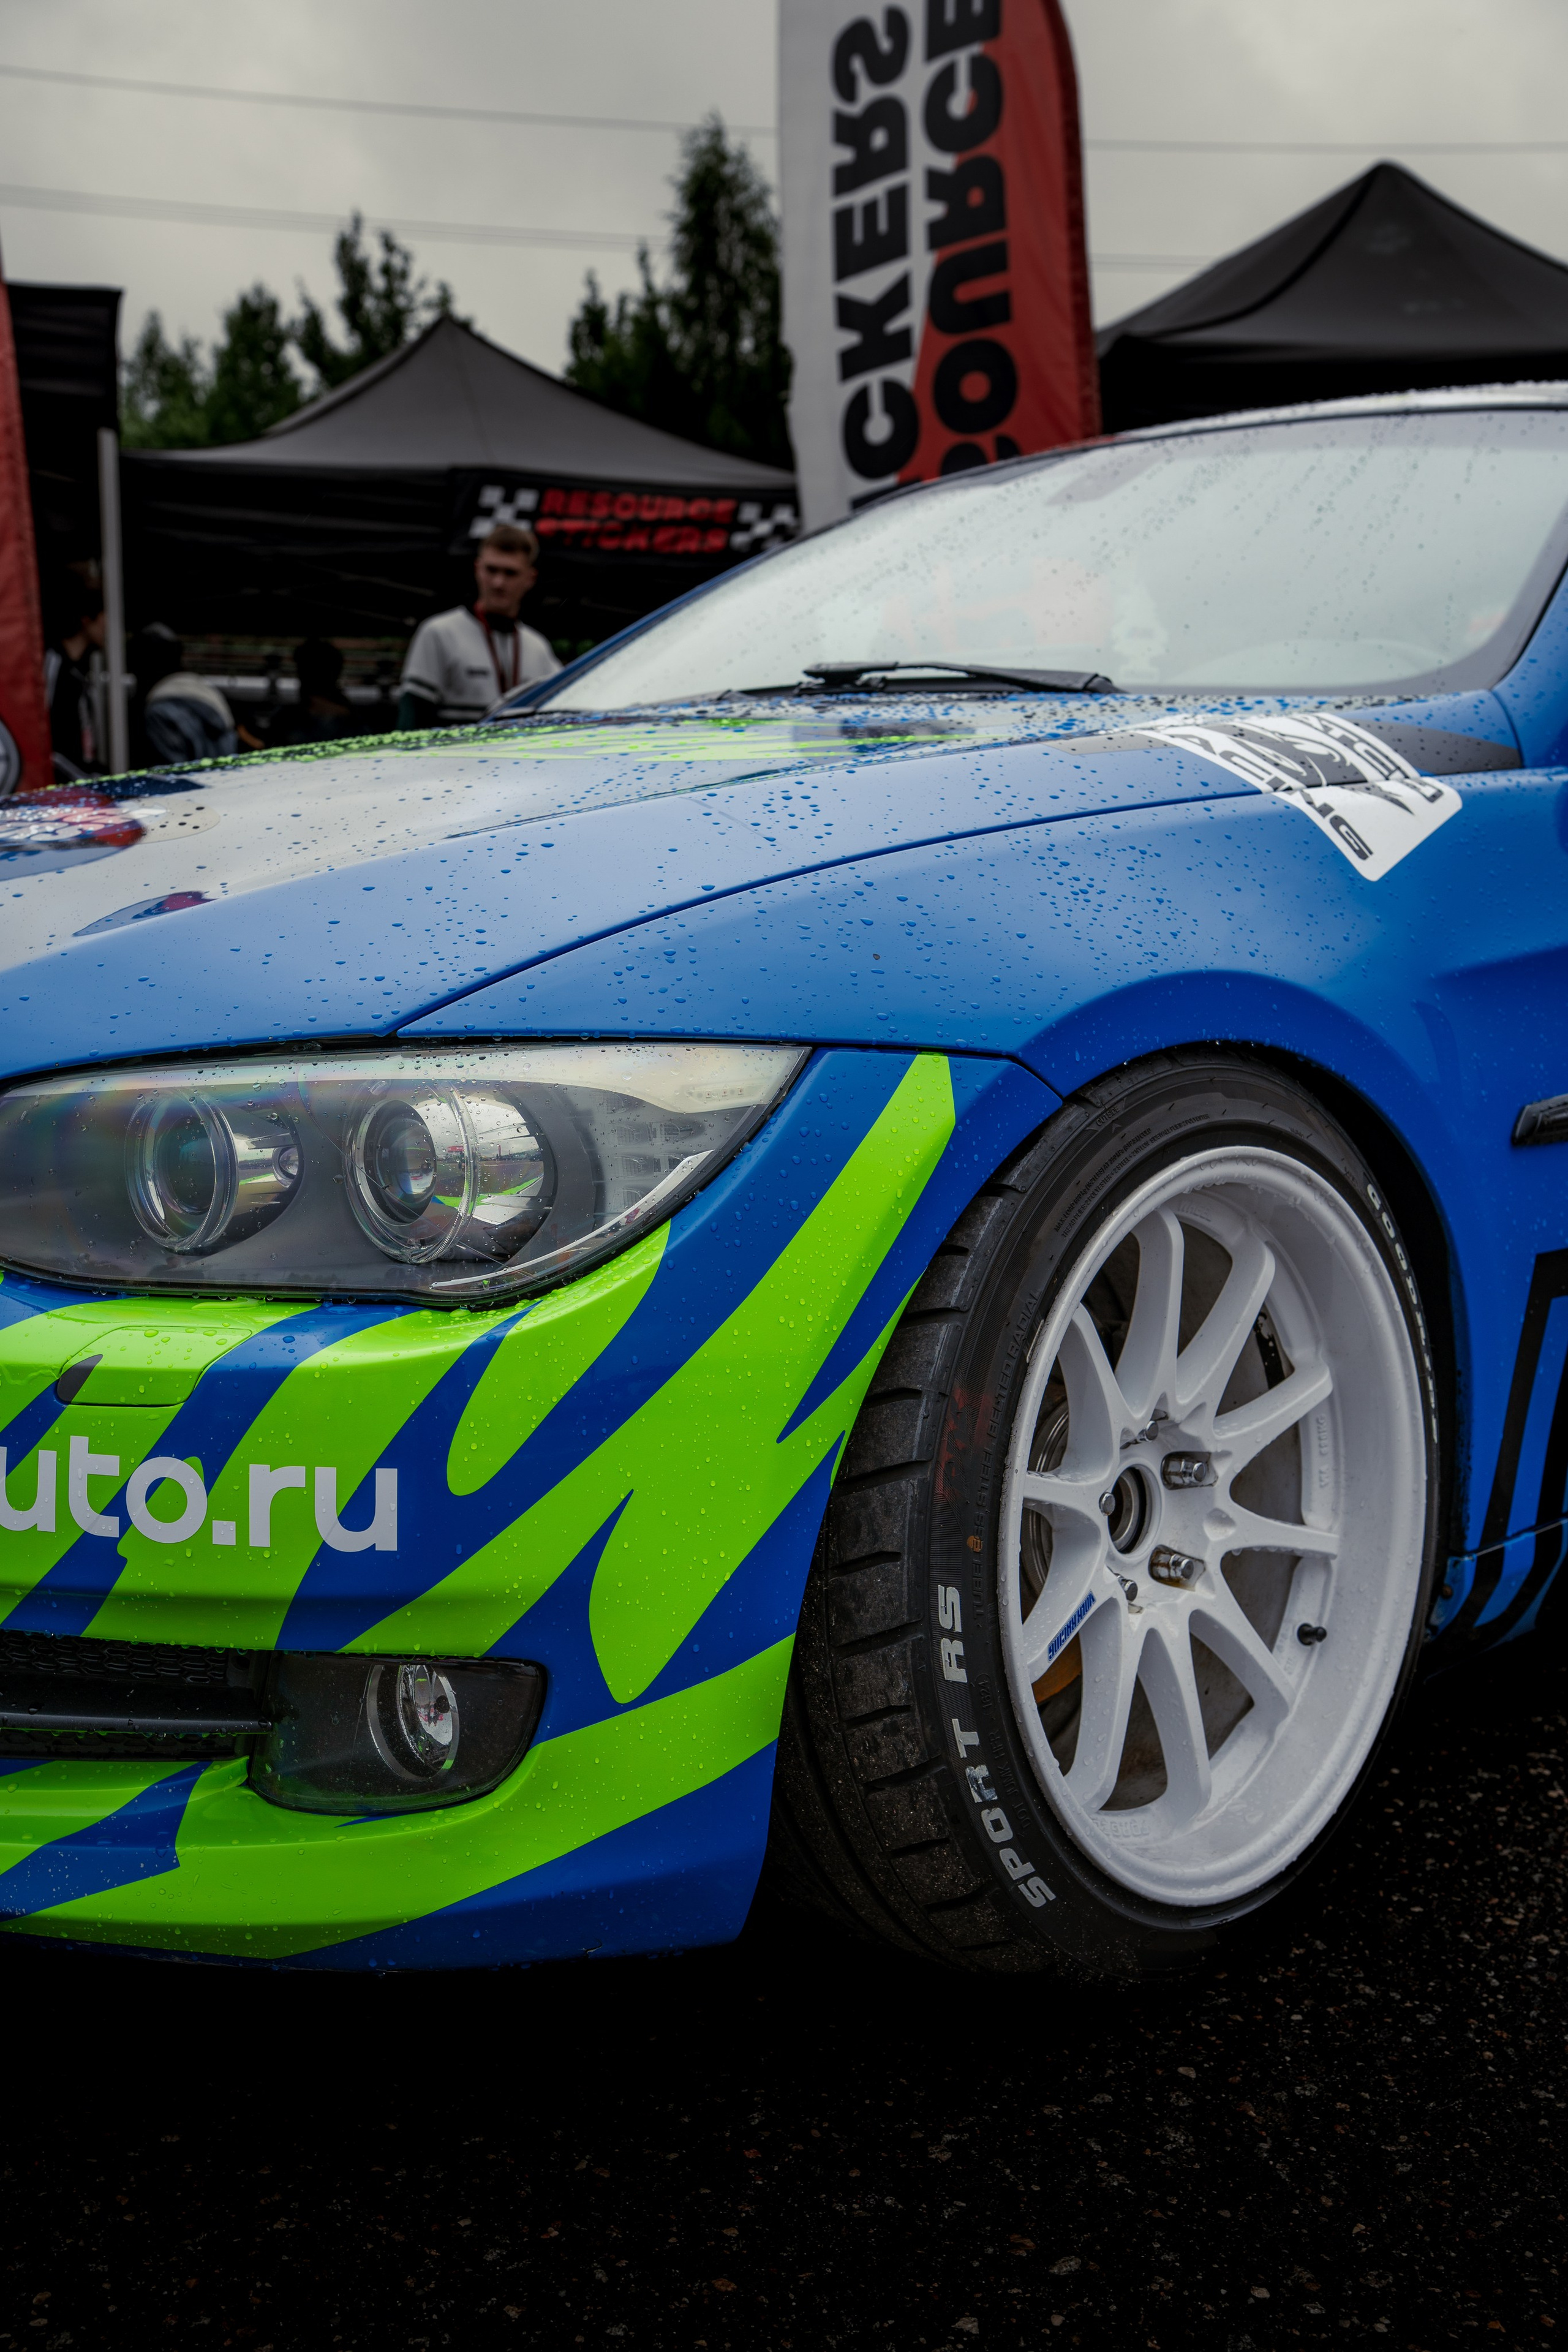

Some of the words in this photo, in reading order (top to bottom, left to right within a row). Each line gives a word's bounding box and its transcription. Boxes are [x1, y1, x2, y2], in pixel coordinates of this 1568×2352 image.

[1161, 733, 1374, 861] ACING
[1096, 1106, 1120, 1126] OUTSIDE
[1006, 1289, 1042, 1359] RADIAL
[938, 1584, 967, 1683] RS
[951, 1718, 1056, 1908] SPORT
